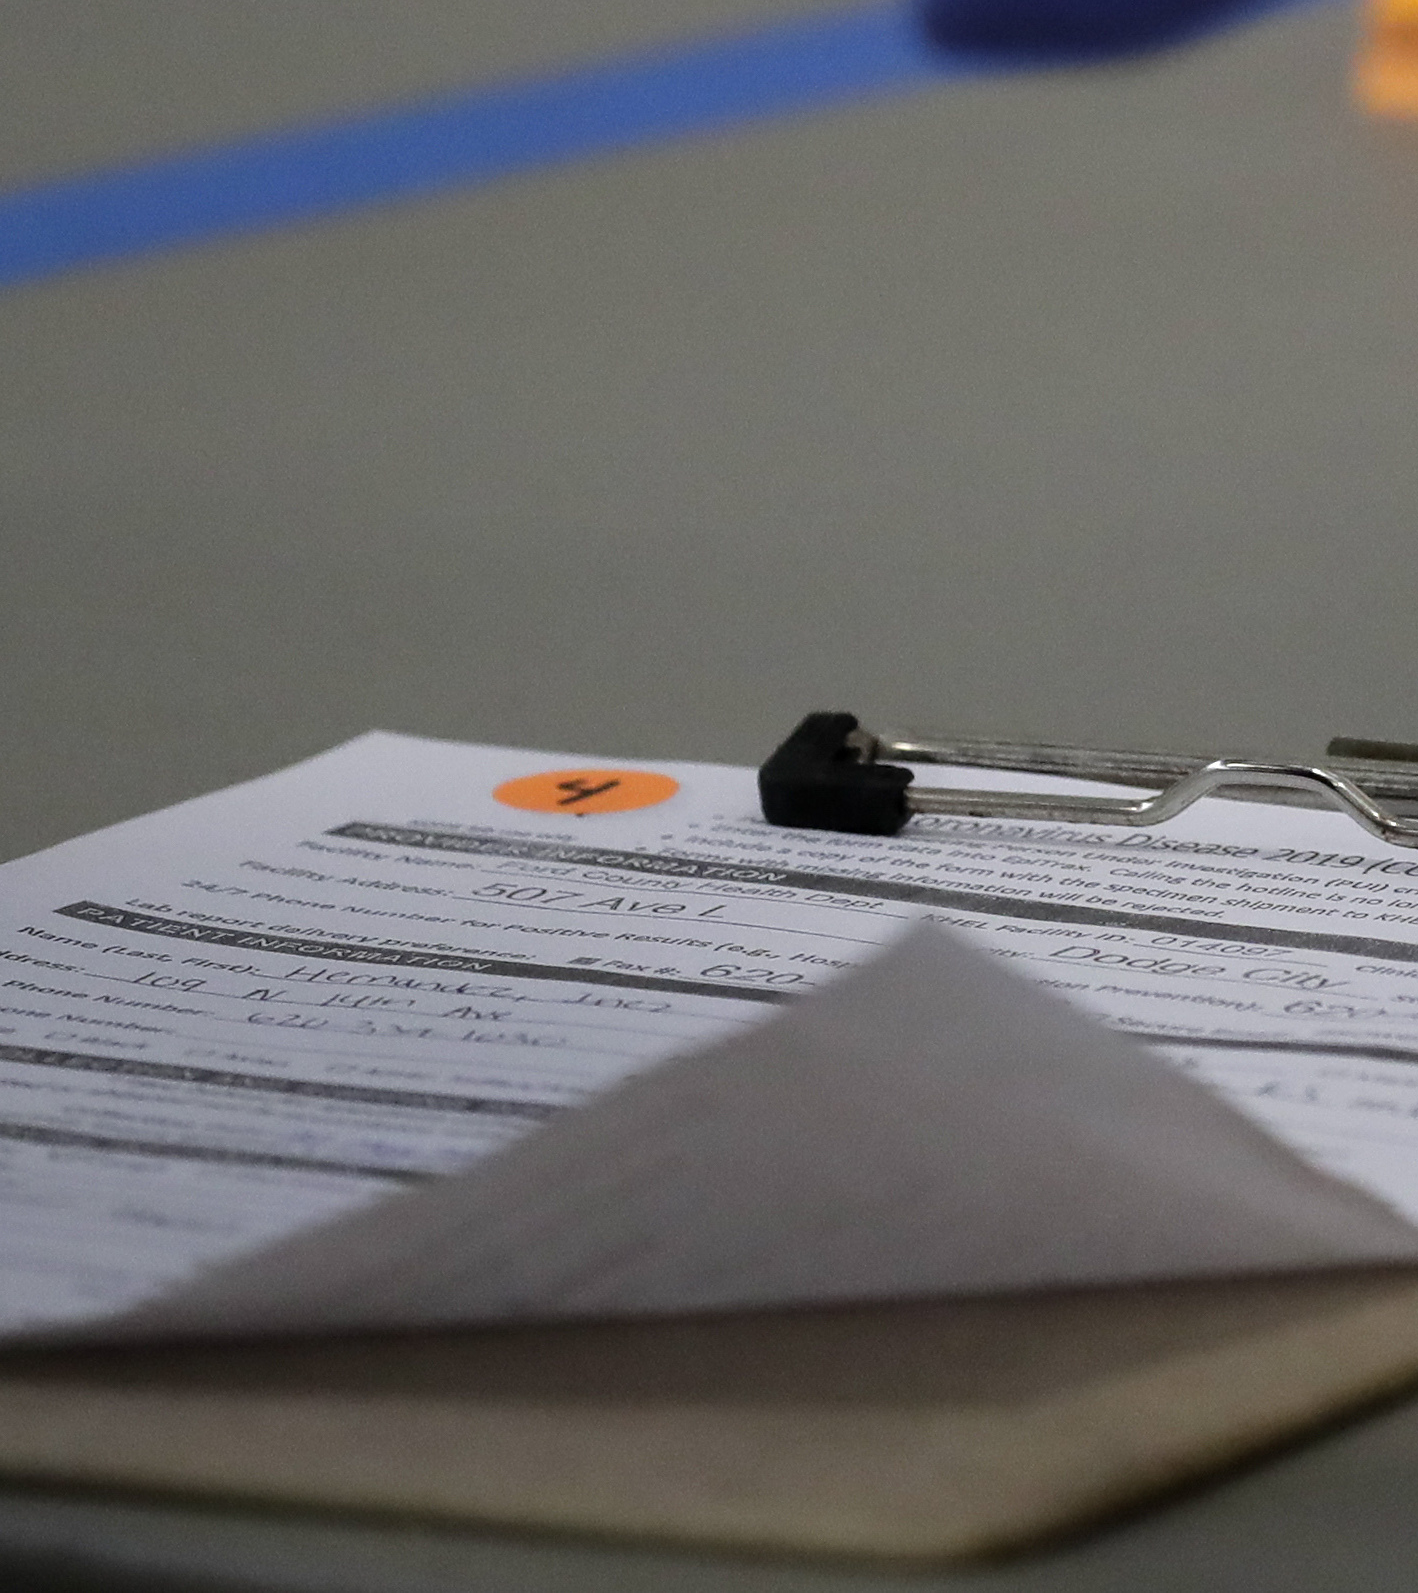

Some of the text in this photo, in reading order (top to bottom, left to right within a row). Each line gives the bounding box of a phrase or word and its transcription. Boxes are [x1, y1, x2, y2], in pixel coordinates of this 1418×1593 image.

[911, 816, 1114, 846] oronavirus
[1116, 833, 1259, 859] Disease
[1268, 848, 1365, 870] 2019
[885, 871, 1032, 897] information
[1038, 889, 1084, 901] will
[1085, 894, 1119, 905] be
[1122, 900, 1224, 919] rejected.
[933, 862, 994, 877] form
[1000, 870, 1053, 884] with
[1057, 876, 1101, 889] the
[1102, 881, 1219, 904] specimen
[1217, 894, 1340, 919] shipment
[1341, 909, 1369, 920] to
[1080, 852, 1163, 867] Under
[1165, 859, 1320, 886] Investigation
[1324, 878, 1390, 894] (PUI)
[1108, 867, 1188, 885] Calling
[1190, 876, 1232, 889] the
[1235, 882, 1322, 901] hotline
[1325, 891, 1348, 903] is
[1351, 896, 1385, 907] no
[250, 892, 336, 910] Phone
[341, 905, 456, 925] Number
[502, 922, 609, 939] Positive
[613, 932, 714, 948] Results
[580, 868, 693, 890] County
[695, 880, 798, 899] Health
[802, 893, 885, 910] Dept
[995, 923, 1090, 940] Facility
[0, 949, 86, 974] ddress:
[17, 925, 99, 951] Name
[76, 906, 494, 972] PATIENT INFORMATION
[123, 897, 173, 914] Lab
[177, 910, 265, 929] report
[267, 923, 380, 945] delivery
[377, 937, 538, 961] preference:
[601, 959, 652, 973] Fax
[471, 882, 581, 904] 507
[577, 896, 687, 915] Ave
[1047, 944, 1227, 976] Dodge
[1242, 966, 1352, 991] City
[1, 979, 89, 1000] Phone
